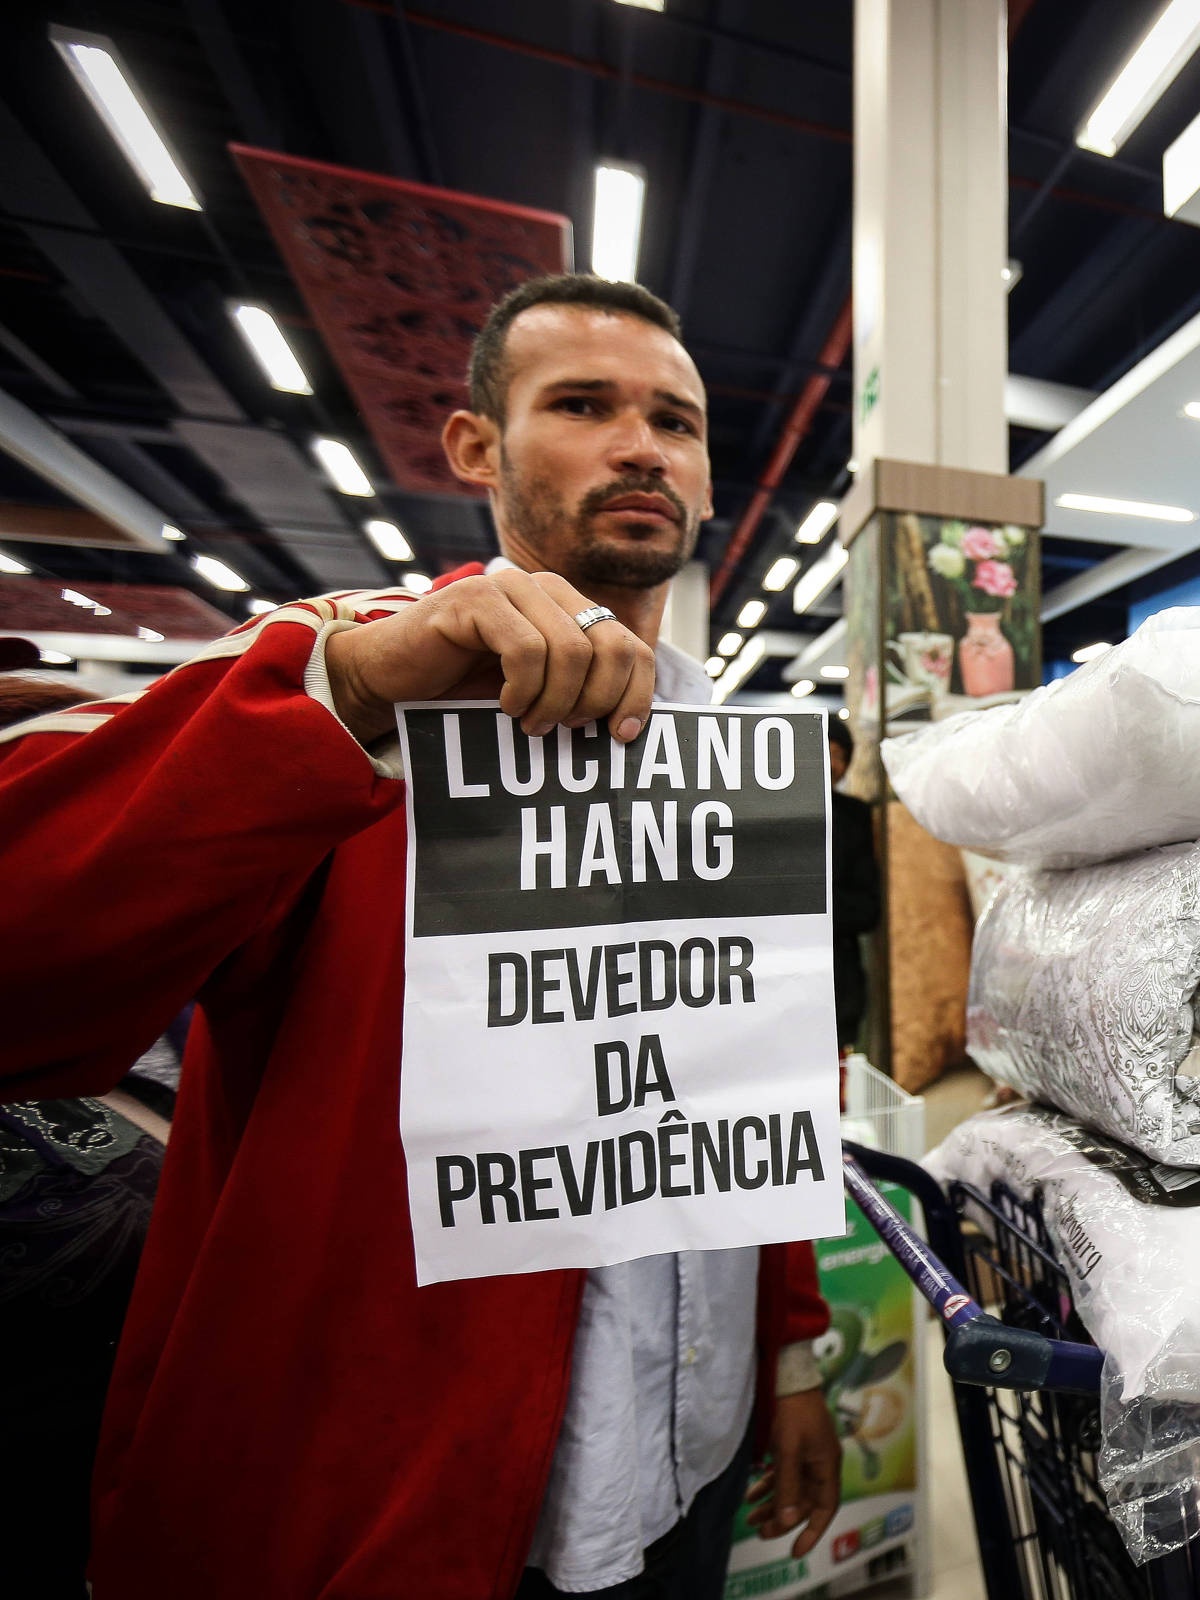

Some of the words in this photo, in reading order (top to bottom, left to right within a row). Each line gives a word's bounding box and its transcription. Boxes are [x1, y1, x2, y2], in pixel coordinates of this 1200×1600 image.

[442, 713, 796, 799] LUCIANO
[519, 800, 735, 890] HANG
[487, 936, 756, 1028] DEVEDOR
[594, 1034, 675, 1117] DA
[435, 1108, 825, 1228] PREVIDÊNCIA
